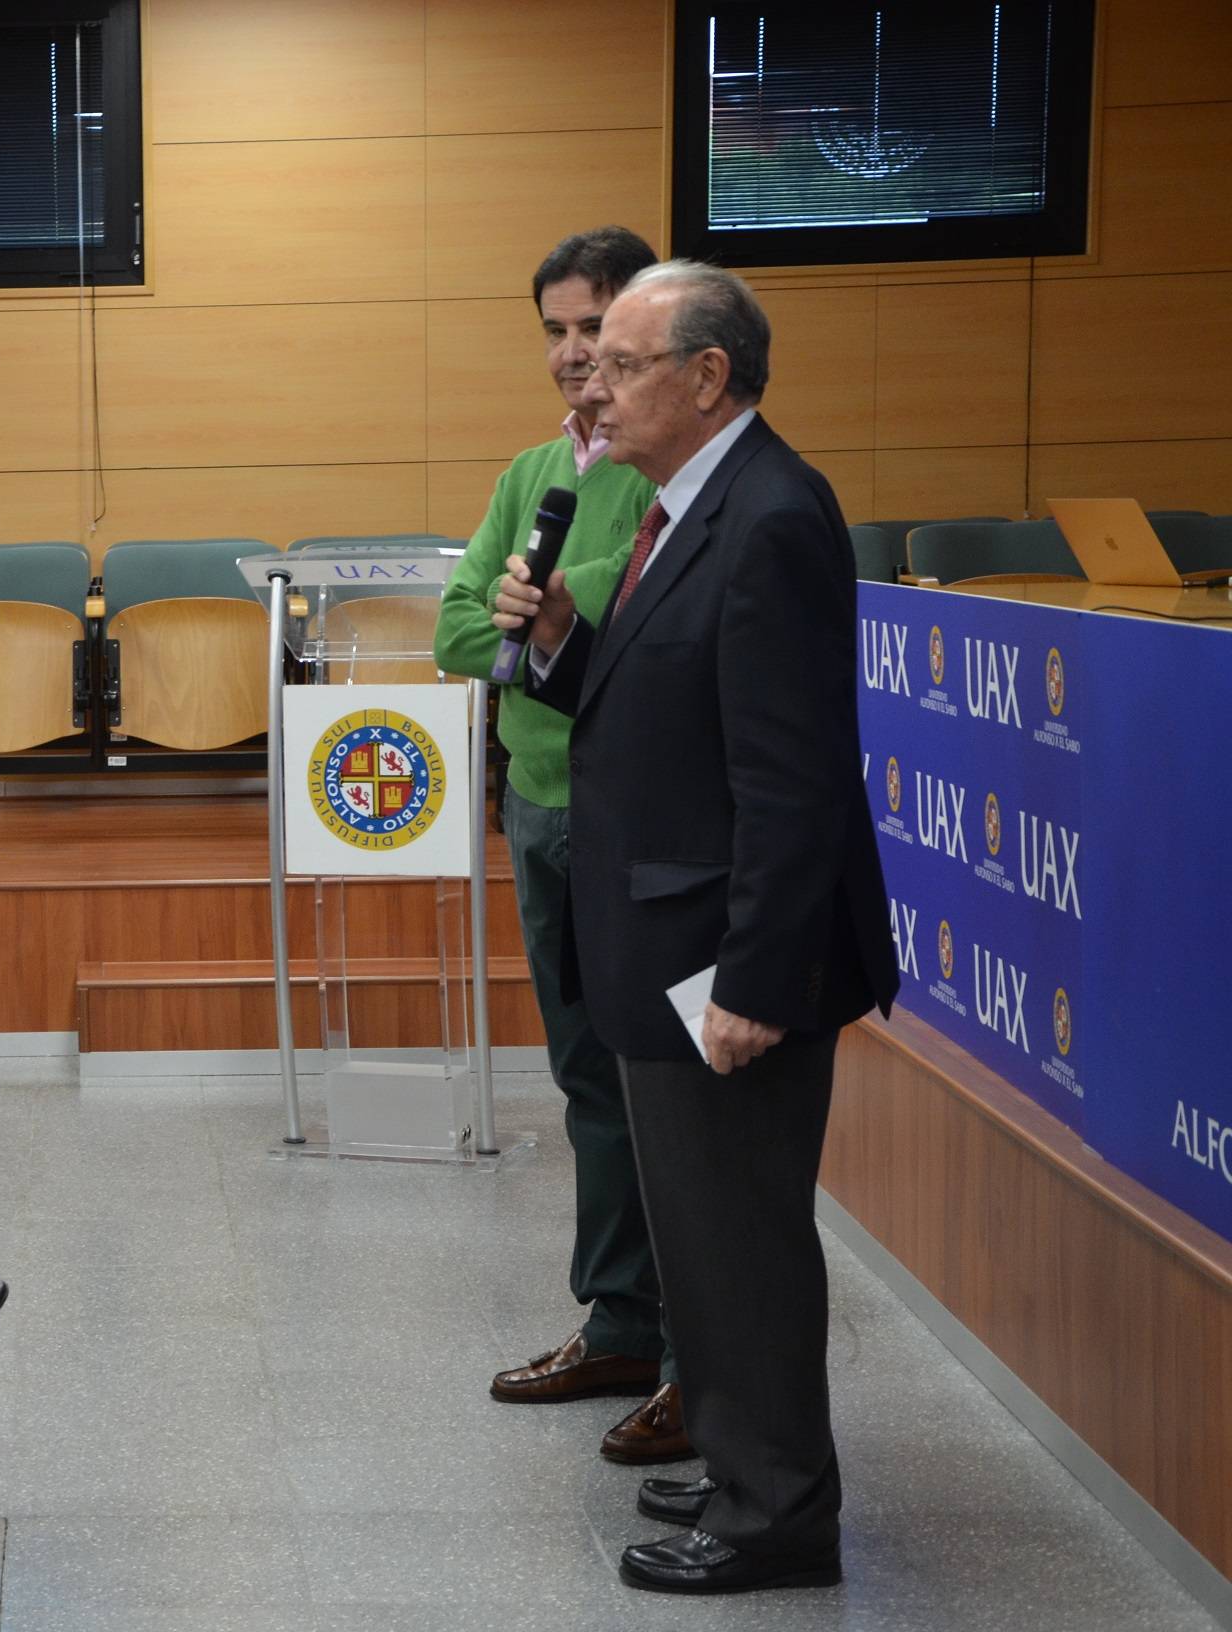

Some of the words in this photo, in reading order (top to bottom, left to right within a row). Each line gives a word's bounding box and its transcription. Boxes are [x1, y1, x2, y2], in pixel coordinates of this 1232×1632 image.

[335, 564, 424, 579] UAX
[862, 619, 911, 697] UAX
[965, 637, 1022, 729] UAX
[323, 719, 352, 748] SUI
[369, 728, 382, 739] X
[402, 741, 418, 763] EL
[402, 721, 442, 793] BONUM
[311, 760, 394, 847] DIFFUSIVUM
[326, 743, 361, 825] ALFONSO
[383, 786, 427, 831] SABIO
[407, 807, 436, 839] EST
[915, 771, 968, 863] UAX
[1019, 811, 1083, 920] UAX
[890, 898, 920, 980] AX
[973, 943, 1030, 1055] UAX
